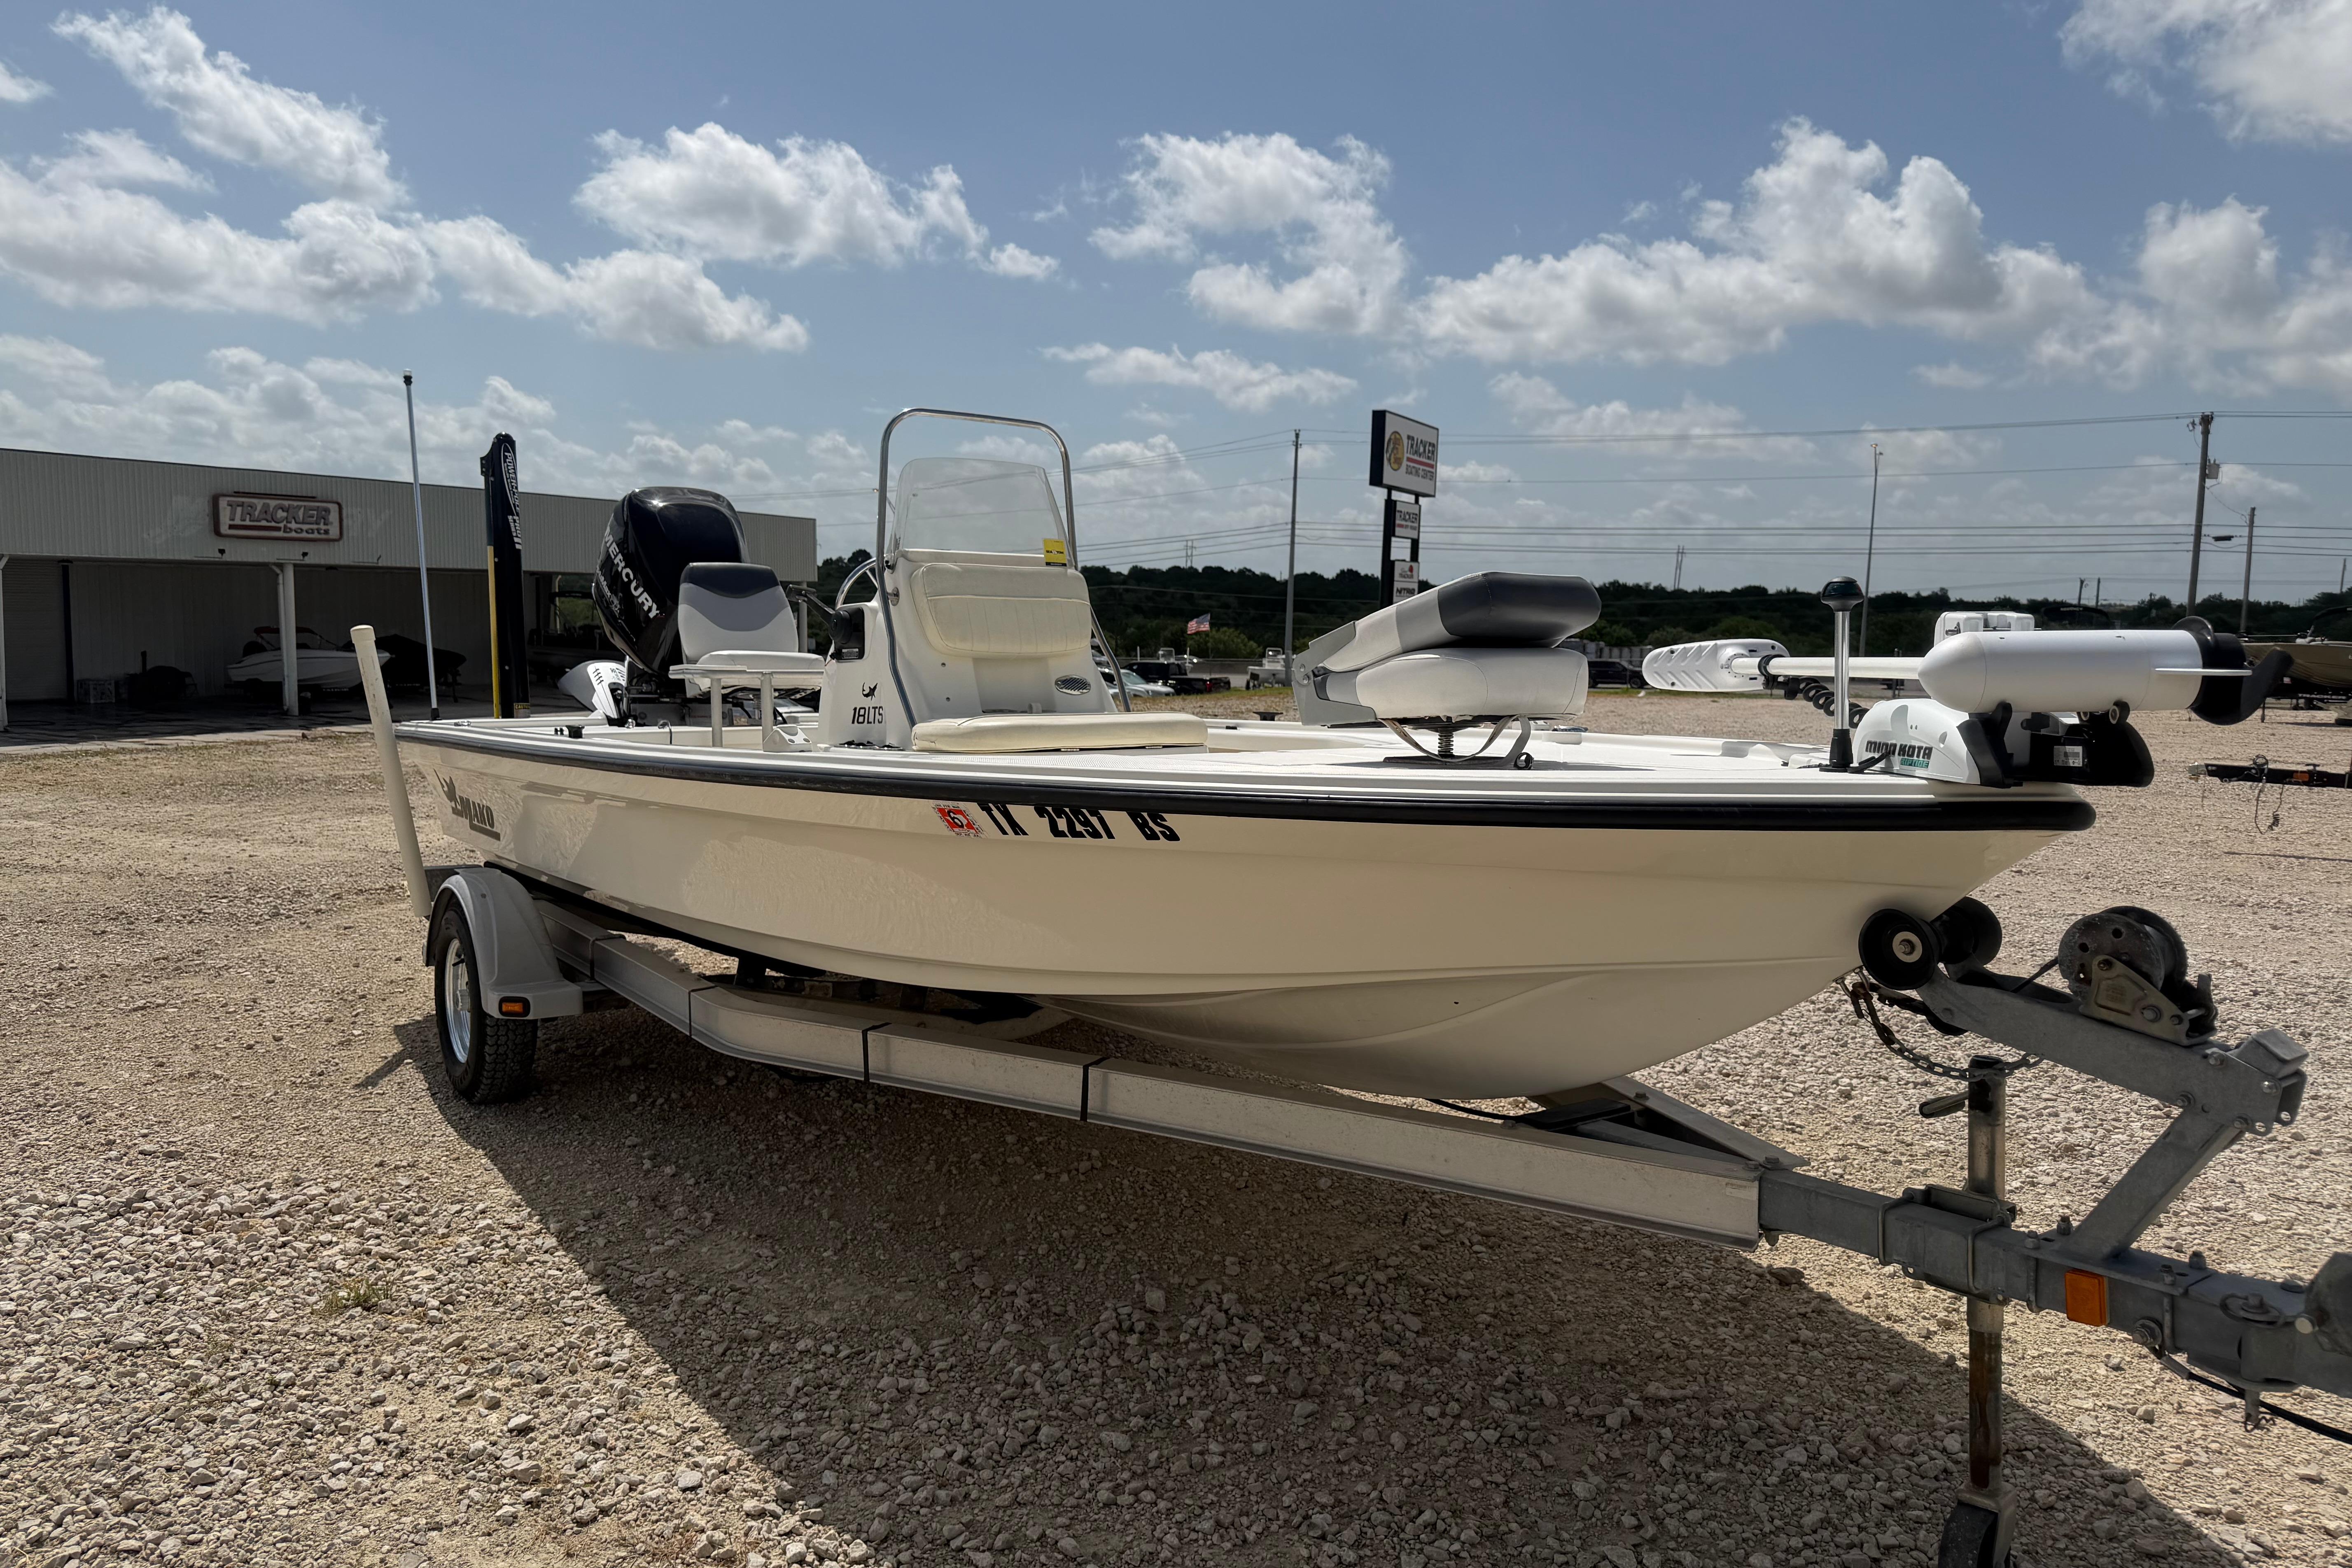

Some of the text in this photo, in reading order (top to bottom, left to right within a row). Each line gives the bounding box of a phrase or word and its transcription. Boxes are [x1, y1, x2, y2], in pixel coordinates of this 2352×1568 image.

[1407, 434, 1435, 462] TRACKER
[504, 452, 520, 514] POWER-POLE
[1405, 464, 1434, 481] BOATING CENTER
[227, 500, 331, 526] TRACKER
[1397, 509, 1418, 523] TRACKER
[282, 524, 330, 535] boats
[513, 516, 521, 537] PRO
[604, 526, 660, 618] MERCURY
[1396, 587, 1416, 596] NITRO
[852, 706, 884, 724] 18LTS
[1865, 740, 1933, 761] MINN KOTA
[1900, 758, 1930, 768] RIPTIDE
[977, 803, 1029, 836] TX
[1034, 806, 1115, 840] 2297
[1126, 812, 1181, 842] BS
